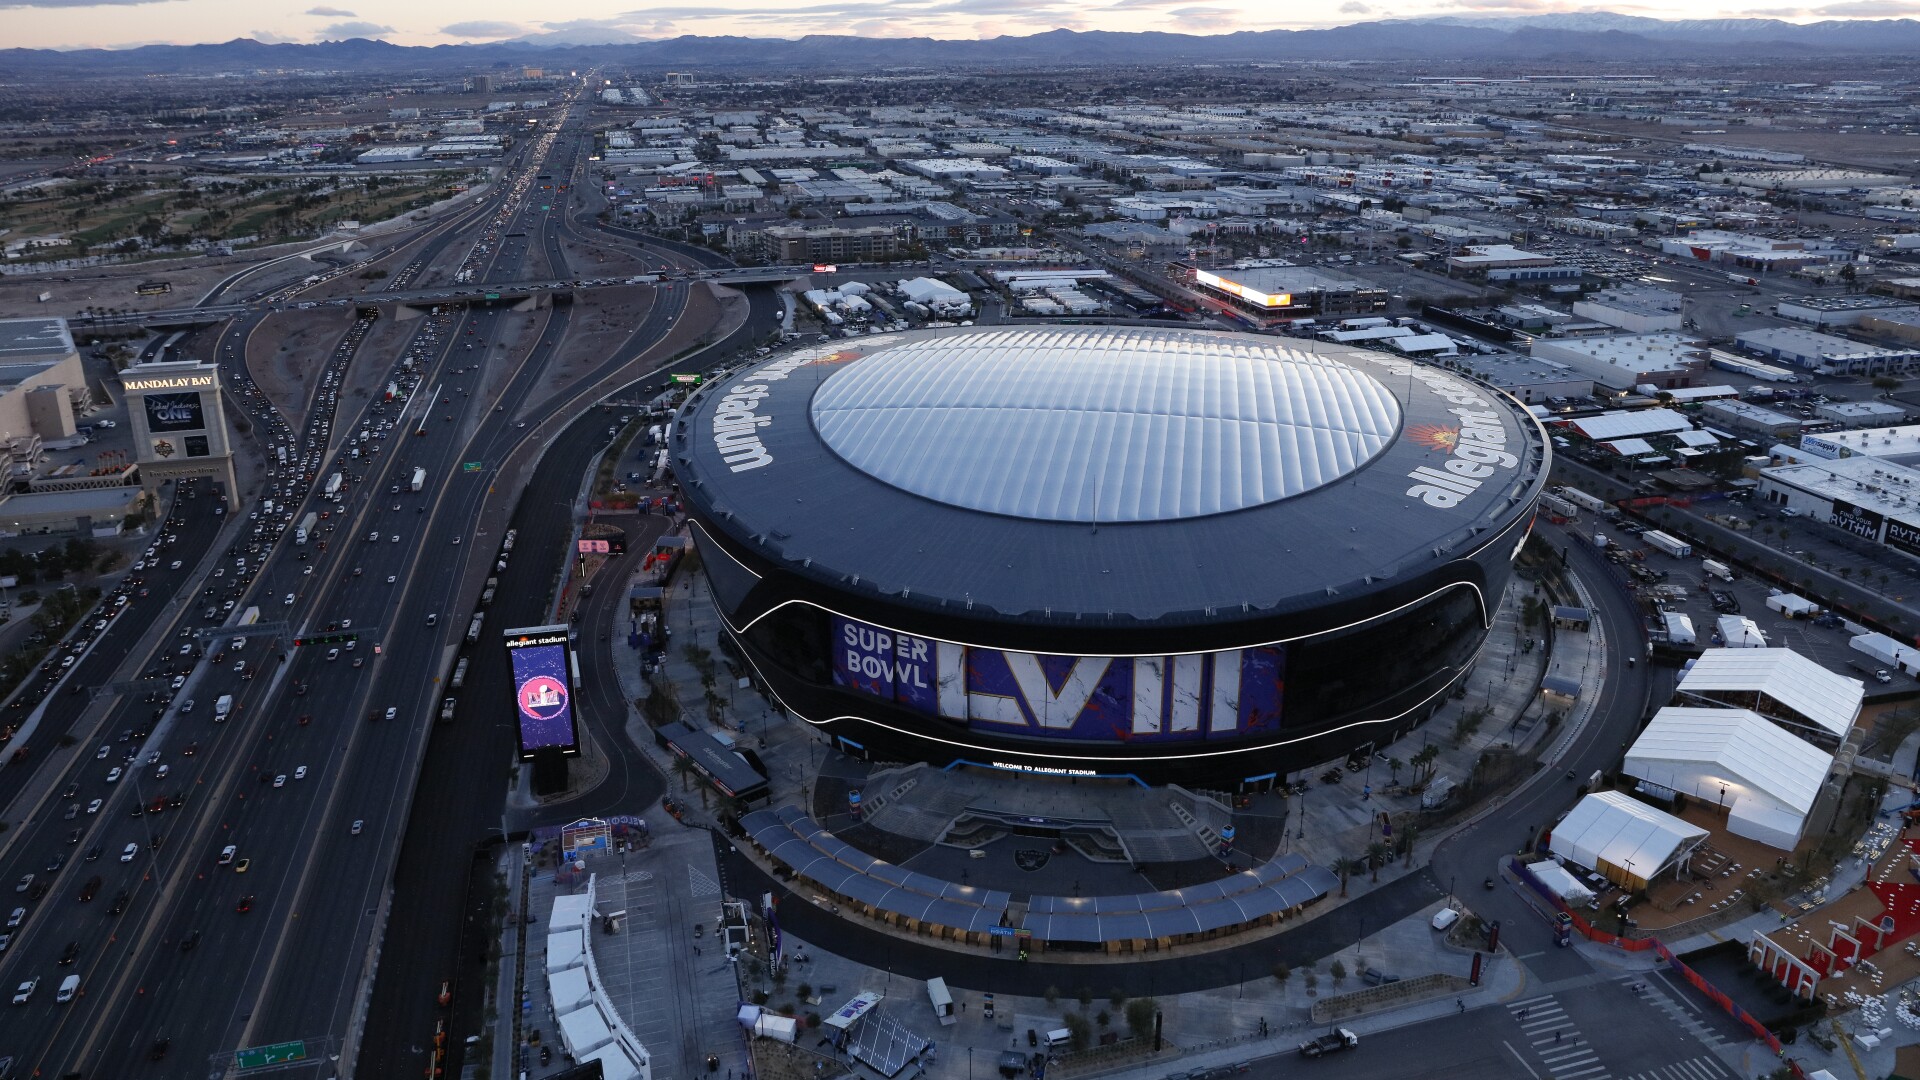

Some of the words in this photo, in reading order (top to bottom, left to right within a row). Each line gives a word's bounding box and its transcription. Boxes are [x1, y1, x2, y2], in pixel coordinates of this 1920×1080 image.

[125, 378, 189, 390] MANDALAY
[191, 377, 212, 386] BAY
[156, 408, 192, 420] ONE
[713, 384, 773, 473] stadium
[1803, 436, 1837, 453] Winsupply
[1406, 407, 1518, 508] allegiant
[1830, 513, 1877, 540] RYTHM
[1840, 511, 1854, 519] FIND
[1855, 517, 1872, 526] YOUR
[506, 638, 537, 648] allegiant
[538, 636, 567, 645] stadium
[844, 623, 929, 662] SUPER
[846, 649, 928, 689] BOWL
[936, 641, 1243, 734] LVIII
[993, 762, 1022, 770] WELCOME
[1034, 766, 1067, 774] ALLEGIANT
